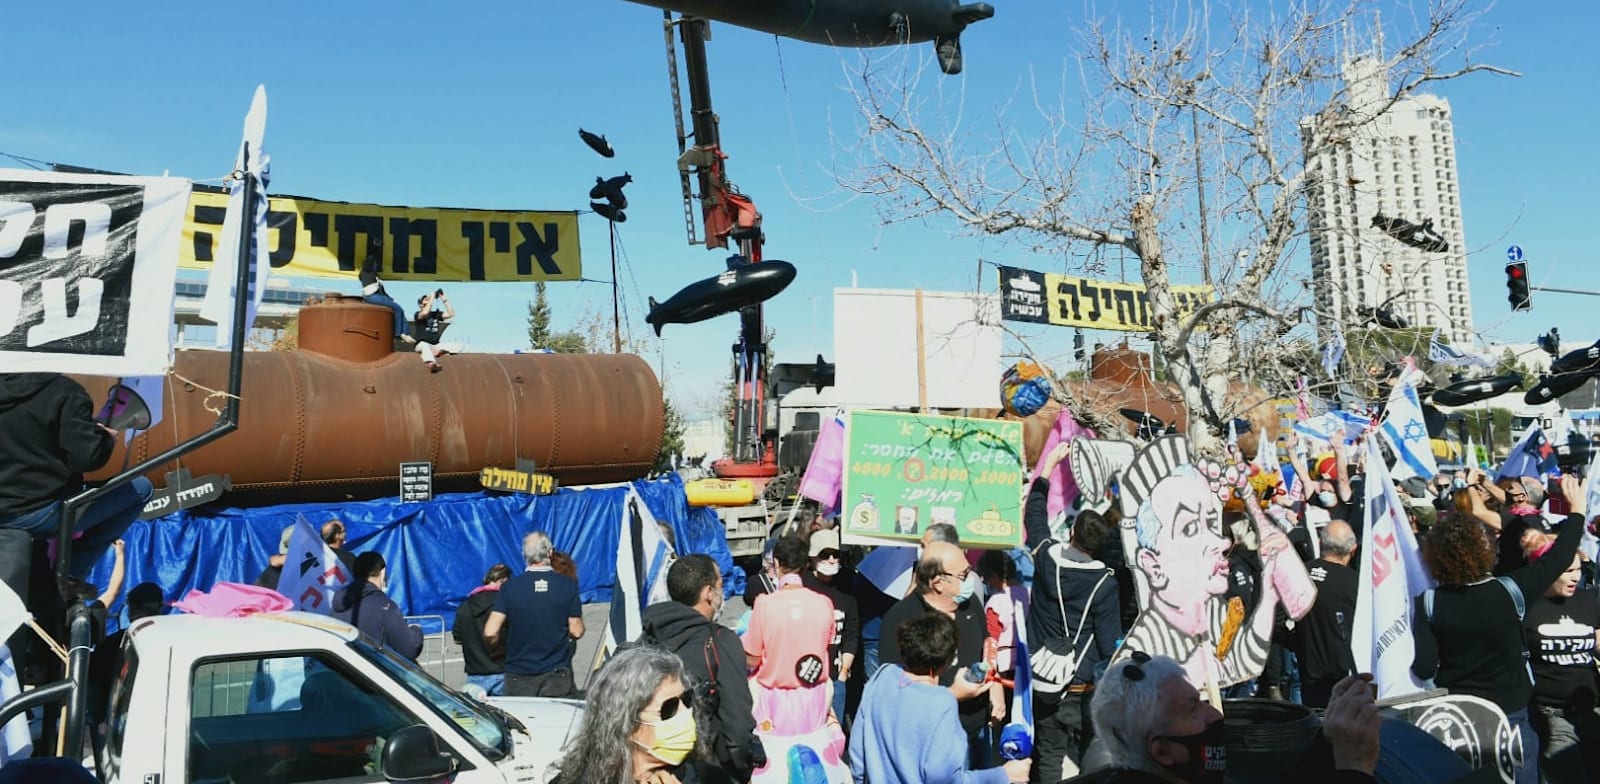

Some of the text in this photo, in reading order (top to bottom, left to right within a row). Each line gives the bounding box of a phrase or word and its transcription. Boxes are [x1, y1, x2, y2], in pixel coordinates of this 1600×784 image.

[461, 221, 562, 280] אין
[481, 467, 553, 495] אין מחילה
[1541, 638, 1595, 652] חקירה
